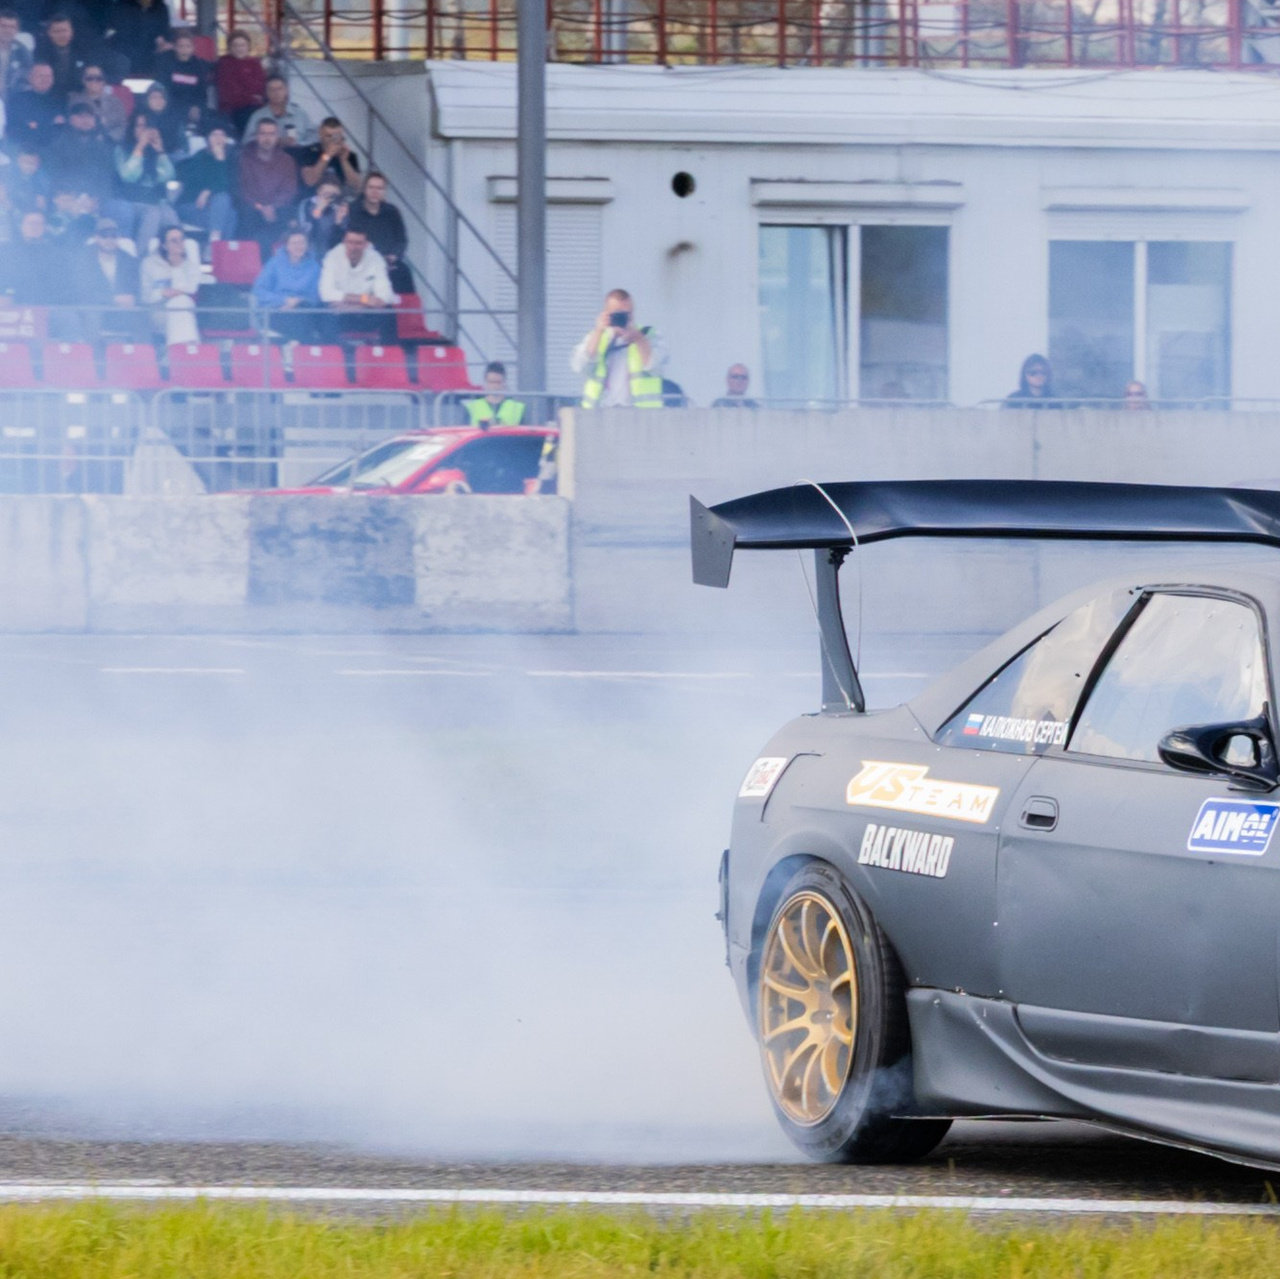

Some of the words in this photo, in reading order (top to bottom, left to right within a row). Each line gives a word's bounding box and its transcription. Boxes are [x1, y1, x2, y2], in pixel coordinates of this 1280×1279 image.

[1034, 718, 1069, 745] СЕРГЕЙ
[909, 785, 990, 814] TEAM
[858, 823, 955, 879] BACKWARD
